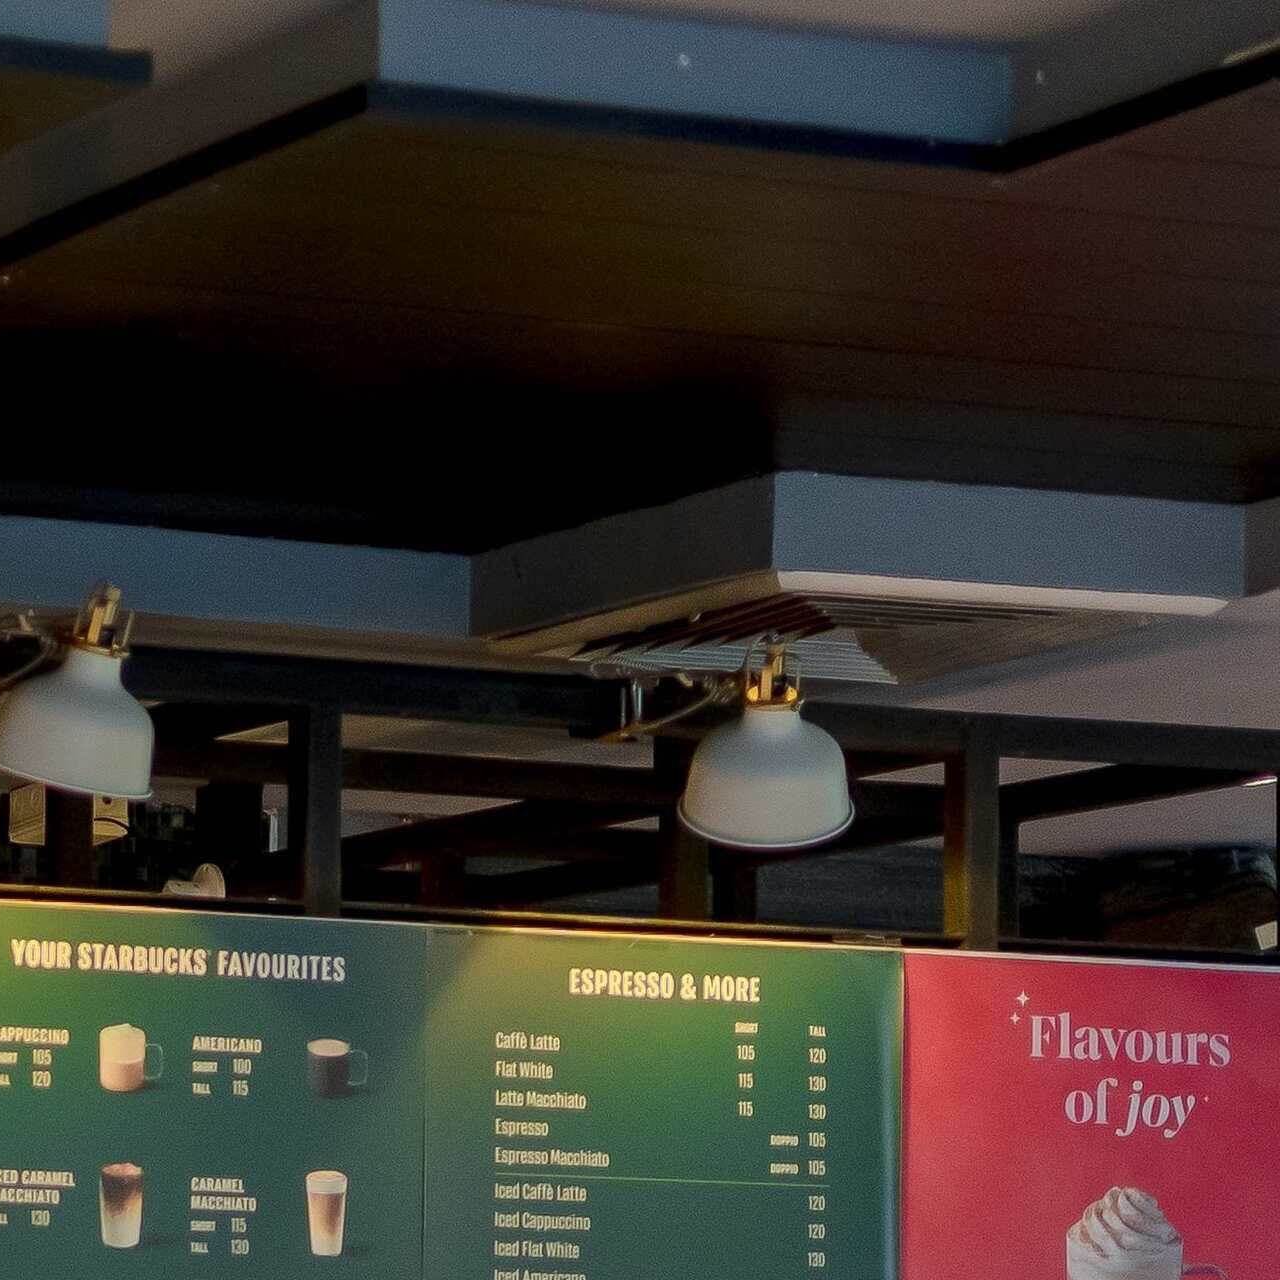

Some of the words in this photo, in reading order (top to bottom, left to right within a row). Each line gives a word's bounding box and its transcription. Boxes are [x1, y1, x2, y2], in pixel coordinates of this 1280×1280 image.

[10, 938, 72, 969] YOUR
[77, 942, 209, 976] STARBUCKS
[217, 950, 346, 982] FAVOURITES
[568, 967, 676, 1000] ESPRESSO
[680, 973, 697, 1000] &
[702, 974, 761, 1002] MORE
[808, 1025, 827, 1037] TALL
[1029, 1012, 1232, 1068] Flavours
[192, 1035, 263, 1054] AMERICANO
[495, 1031, 527, 1050] Caffè
[530, 1033, 561, 1051] Latte
[736, 1045, 755, 1060] 105
[808, 1047, 827, 1064] 120
[31, 1070, 52, 1088] 120
[495, 1060, 517, 1078] Flat
[519, 1062, 553, 1080] White
[808, 1075, 826, 1092] 130
[495, 1089, 524, 1107] Latte
[526, 1091, 587, 1110] Macchiato
[1063, 1077, 1119, 1126] of
[1116, 1079, 1197, 1138] joy
[808, 1104, 826, 1120] 130
[495, 1118, 549, 1137] Espresso
[808, 1132, 826, 1148] 105
[495, 1146, 549, 1165] Espresso
[550, 1149, 610, 1168] Macchiato
[808, 1160, 826, 1176] 105
[21, 1170, 76, 1187] CARAMEL
[191, 1177, 245, 1193] CARAMEL
[494, 1182, 520, 1200] Iced
[522, 1183, 554, 1201] Caffè
[556, 1184, 587, 1202] Latte
[191, 1195, 257, 1212] MACCHIATO
[808, 1195, 825, 1211] 120
[494, 1211, 520, 1228] Iced
[521, 1212, 591, 1232] Cappuccino
[808, 1223, 825, 1240] 120
[494, 1240, 519, 1257] Iced
[521, 1240, 544, 1257] Flat
[545, 1241, 580, 1259] White
